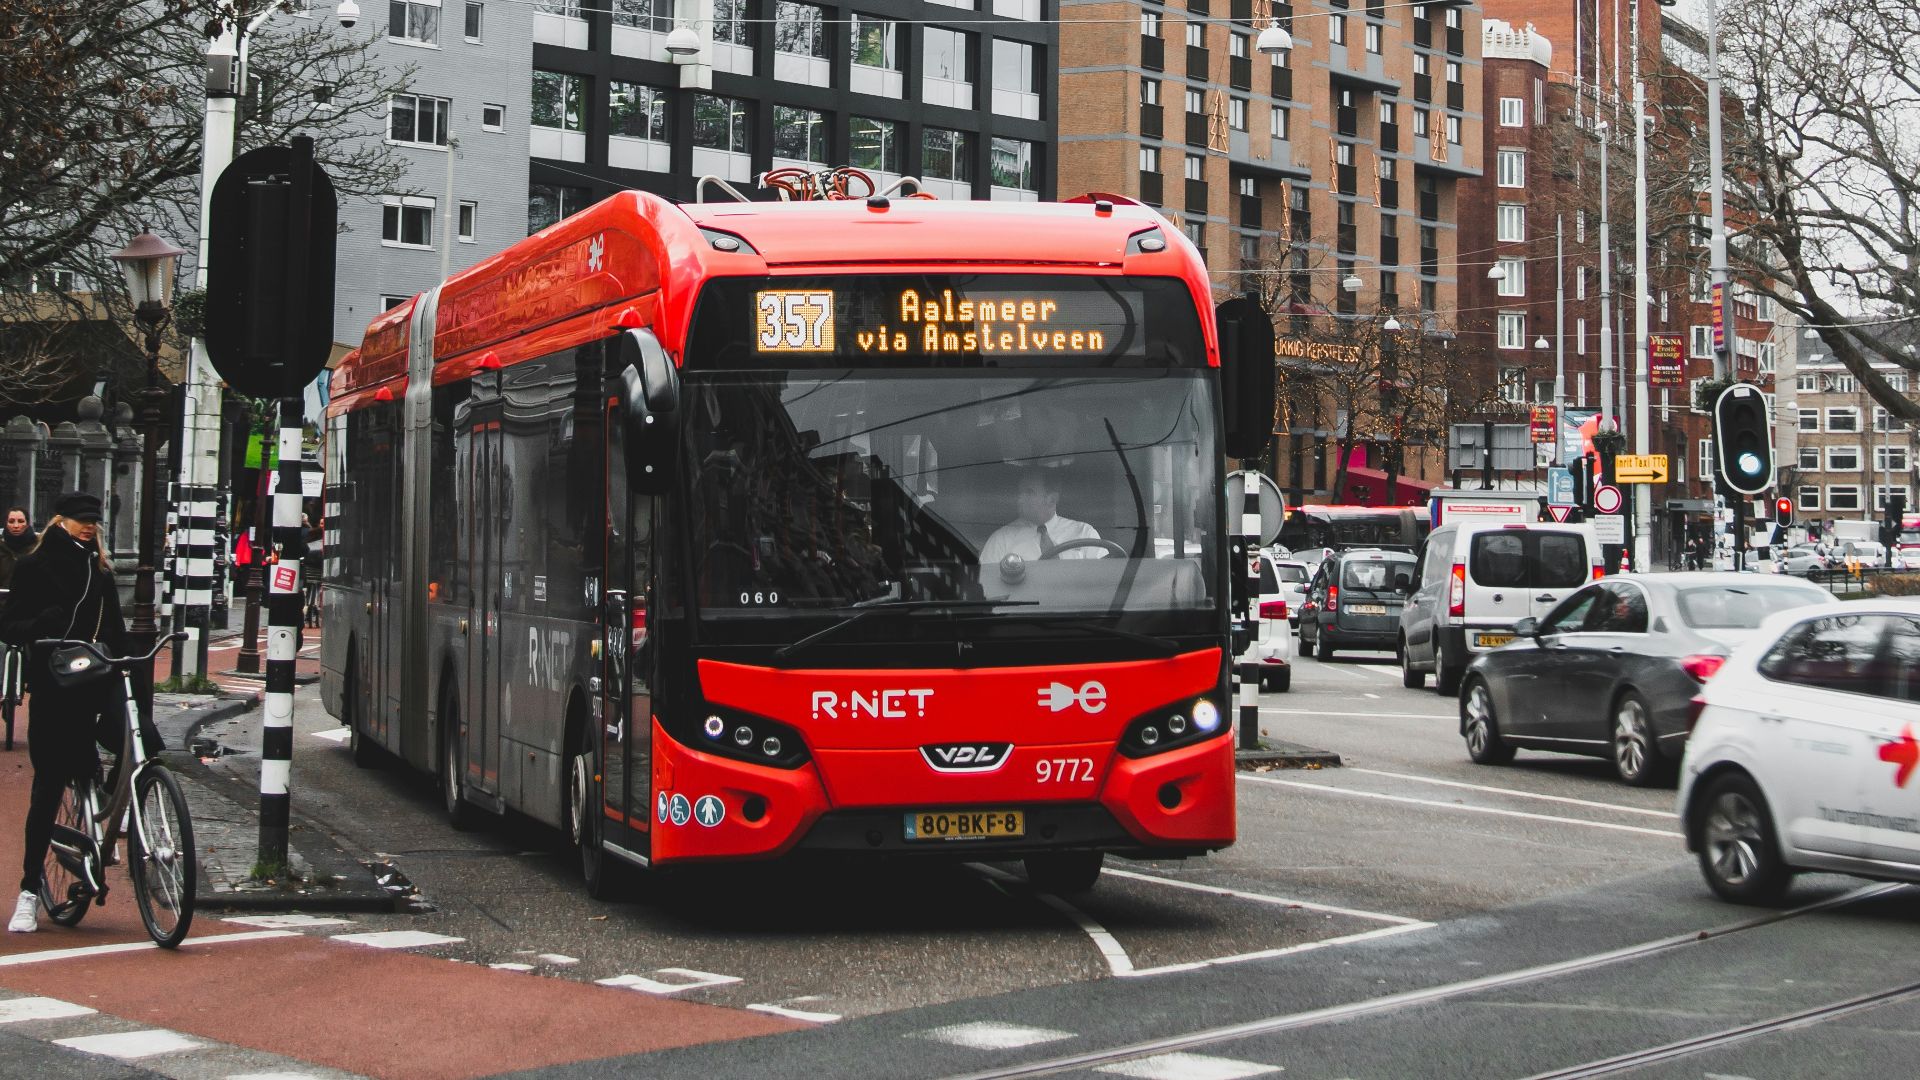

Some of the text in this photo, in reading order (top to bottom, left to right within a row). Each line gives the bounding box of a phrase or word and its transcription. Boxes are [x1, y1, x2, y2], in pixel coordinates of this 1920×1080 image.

[901, 289, 1056, 322] Aalsmeer
[760, 294, 832, 348] 357
[858, 323, 1104, 351] via Amstelveen
[1650, 335, 1682, 346] VIENNA
[1616, 457, 1632, 468] Inrit
[1634, 456, 1650, 468] Taxi
[935, 746, 995, 764] VDL
[1035, 758, 1095, 784] 9772
[922, 813, 1017, 835] 80-BKF-8
